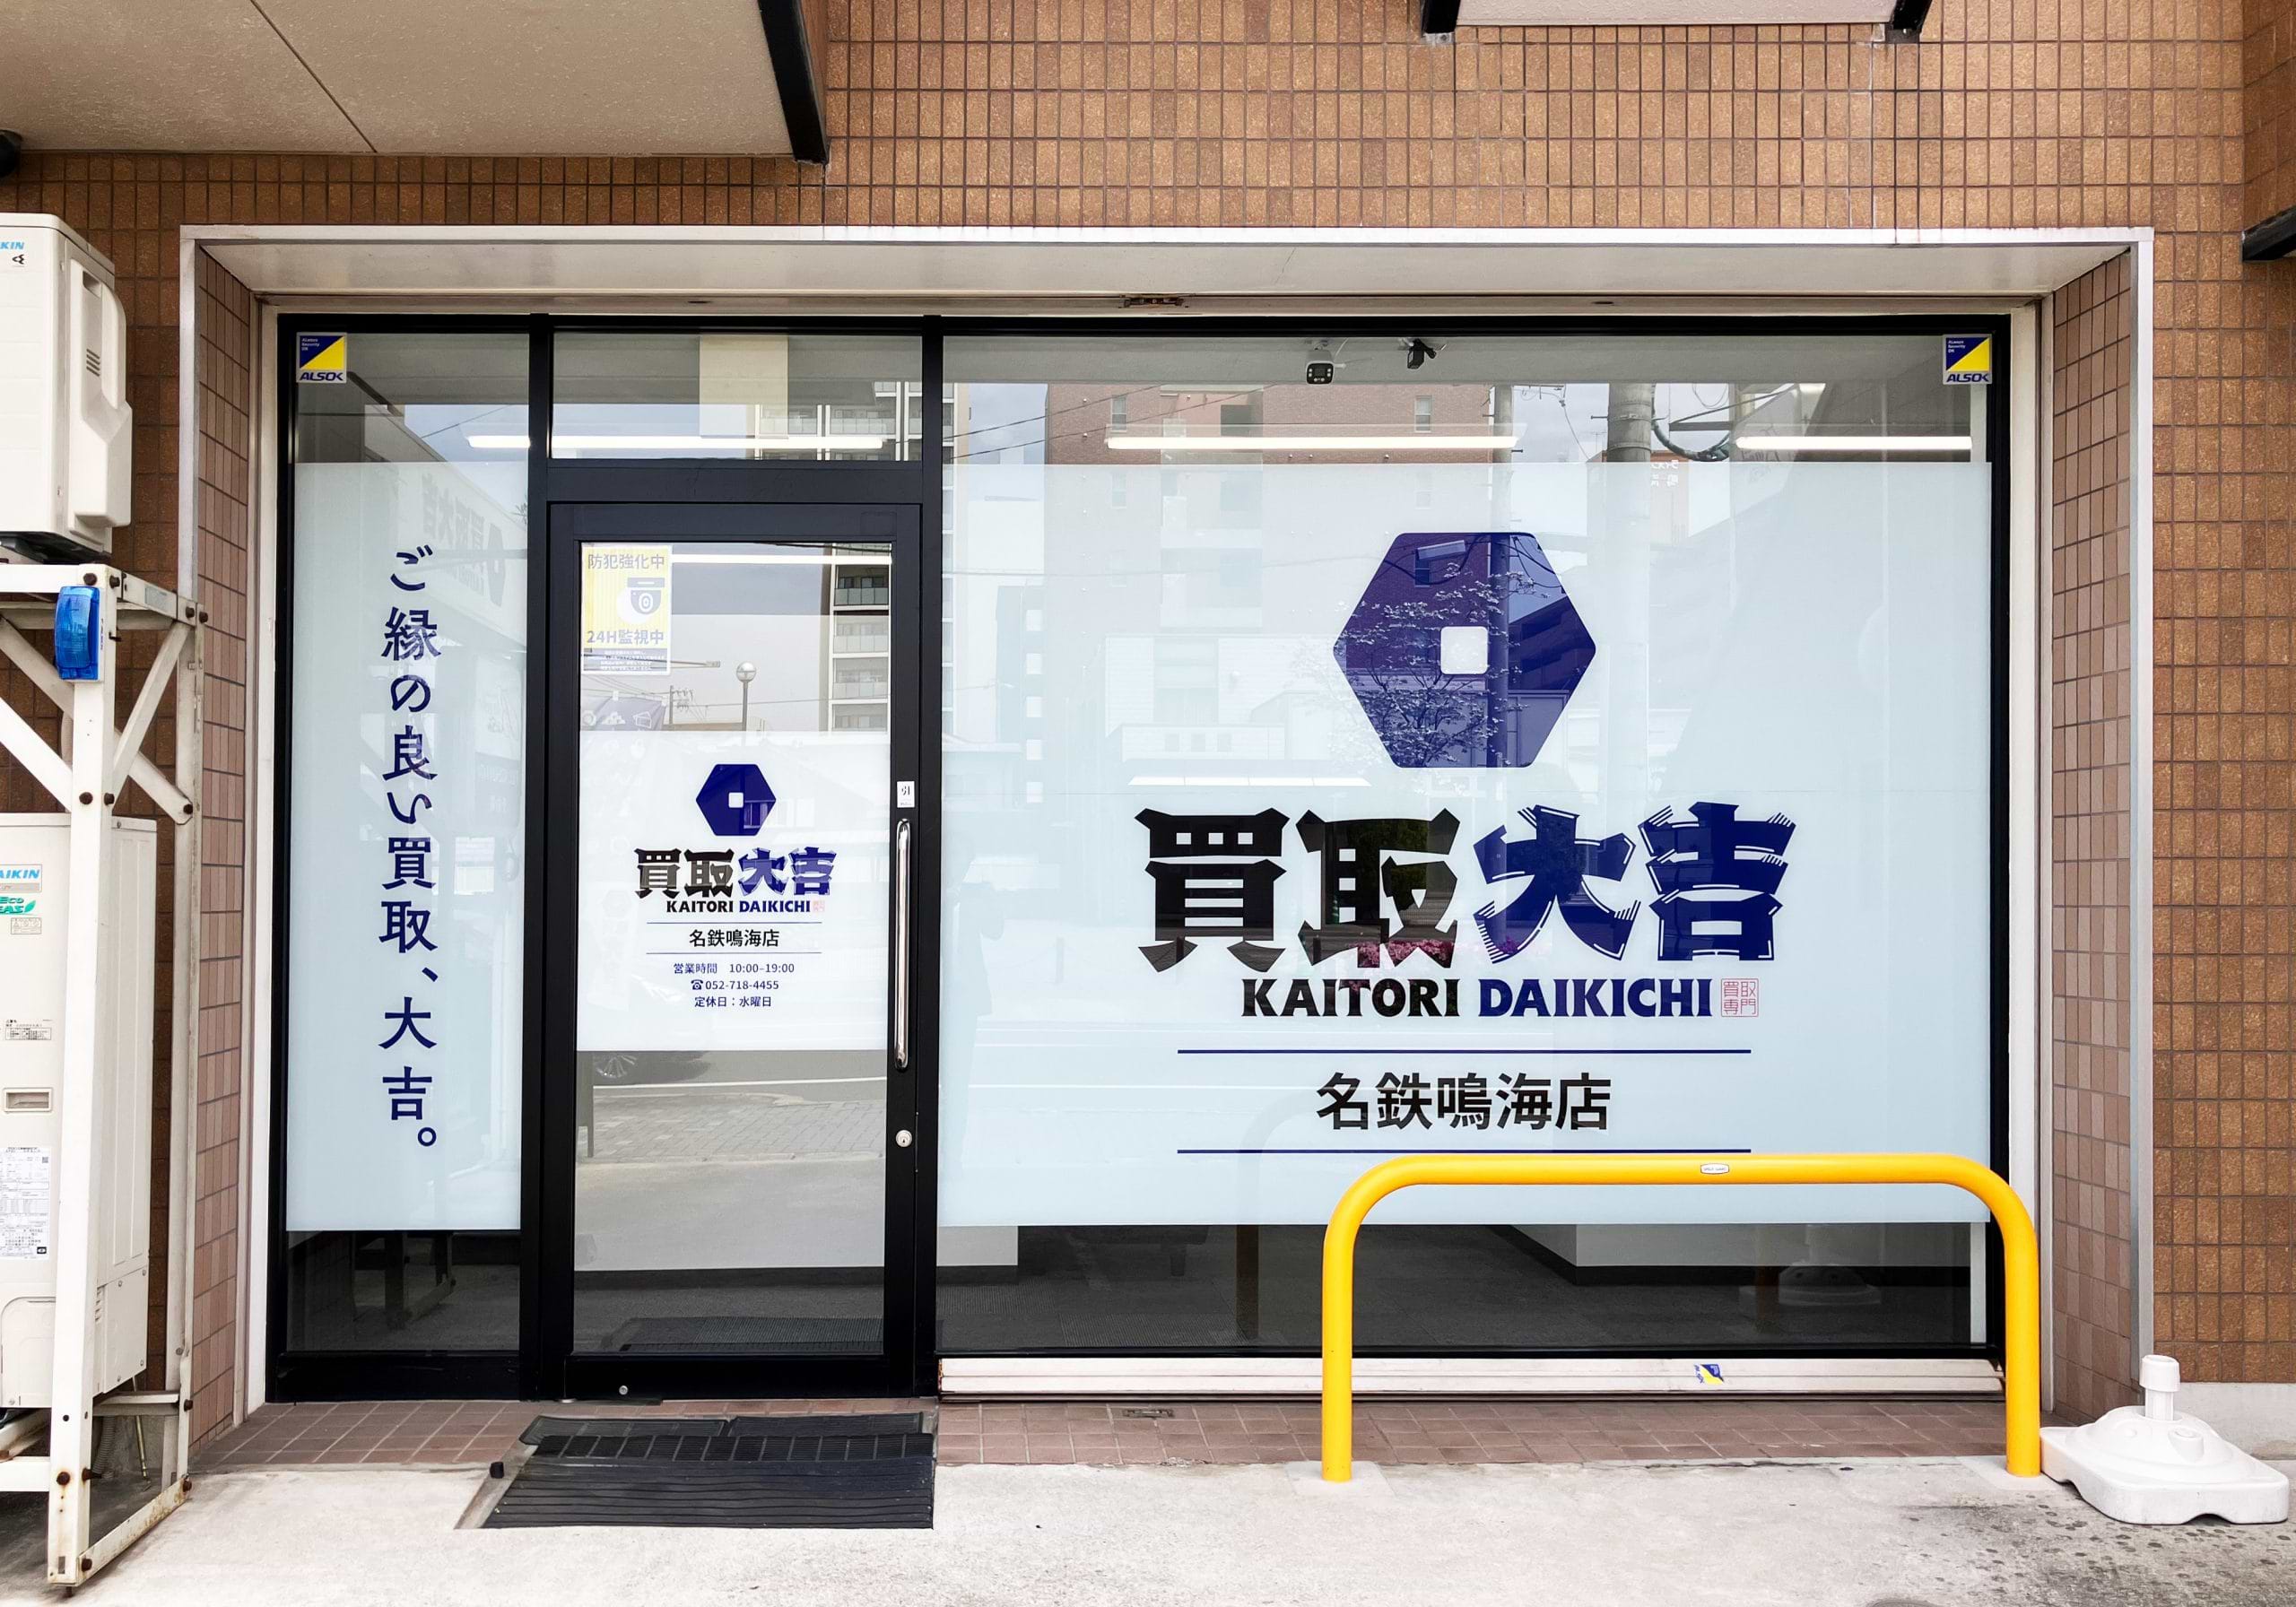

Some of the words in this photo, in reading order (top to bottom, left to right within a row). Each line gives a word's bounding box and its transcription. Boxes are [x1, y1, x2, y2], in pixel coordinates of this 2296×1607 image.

[300, 371, 344, 381] ALSOK
[1946, 373, 1989, 382] ALSOK
[587, 553, 665, 569] 防犯強化中
[587, 629, 664, 645] 24H監視中
[378, 544, 441, 1147] ご縁の良い買取、大吉。
[634, 847, 838, 899] 買取大吉
[1135, 801, 1796, 973] 買取大吉
[666, 900, 734, 913] KAITORI
[739, 900, 811, 913] DAIKICHI
[689, 929, 780, 948] 名鉄鳴海店
[674, 963, 718, 974] 営業時間
[729, 963, 795, 973] 10:00-19:00
[705, 980, 779, 990] 052-718-4455
[1723, 981, 1756, 997] 買取
[694, 995, 771, 1007] 定休日：水曜日
[1241, 977, 1460, 1018] KAITORI
[1478, 977, 1713, 1018] DAIKICHI
[1316, 1072, 1612, 1131] 名鉄鳴海店
